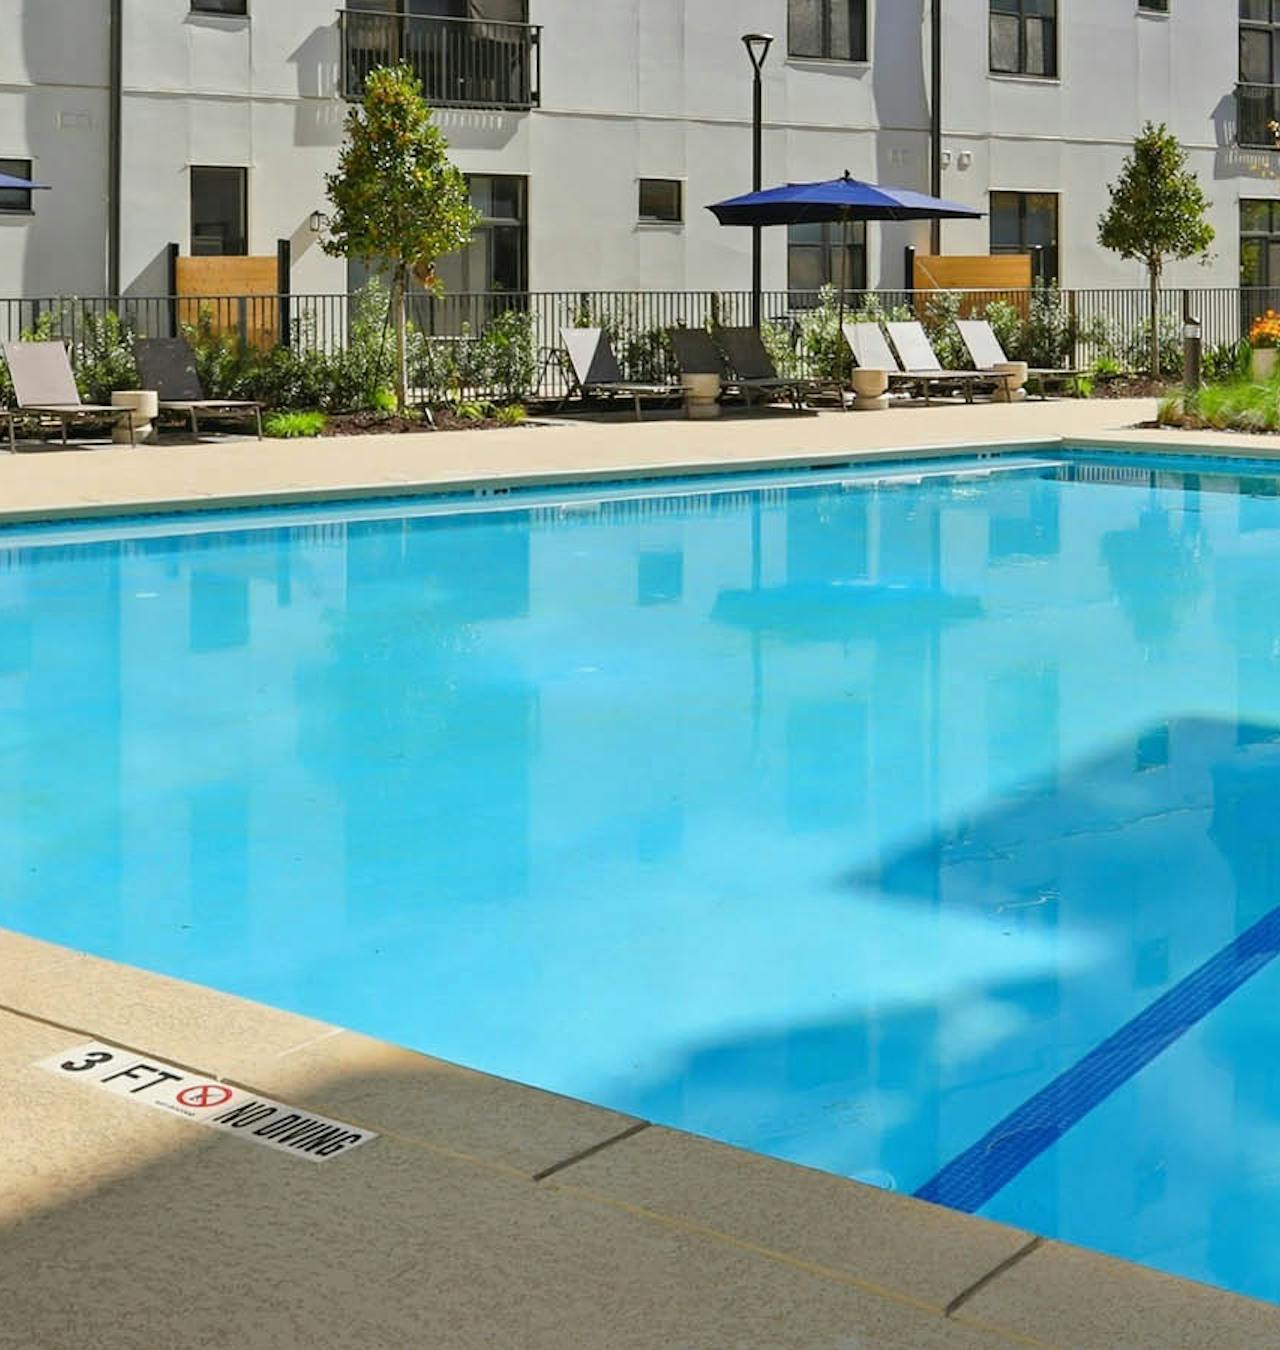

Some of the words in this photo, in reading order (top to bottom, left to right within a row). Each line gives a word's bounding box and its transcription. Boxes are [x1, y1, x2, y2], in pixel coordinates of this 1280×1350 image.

[60, 1051, 113, 1072] 3
[101, 1063, 184, 1093] FT
[213, 1101, 278, 1128] NO
[252, 1114, 363, 1157] DIVING
